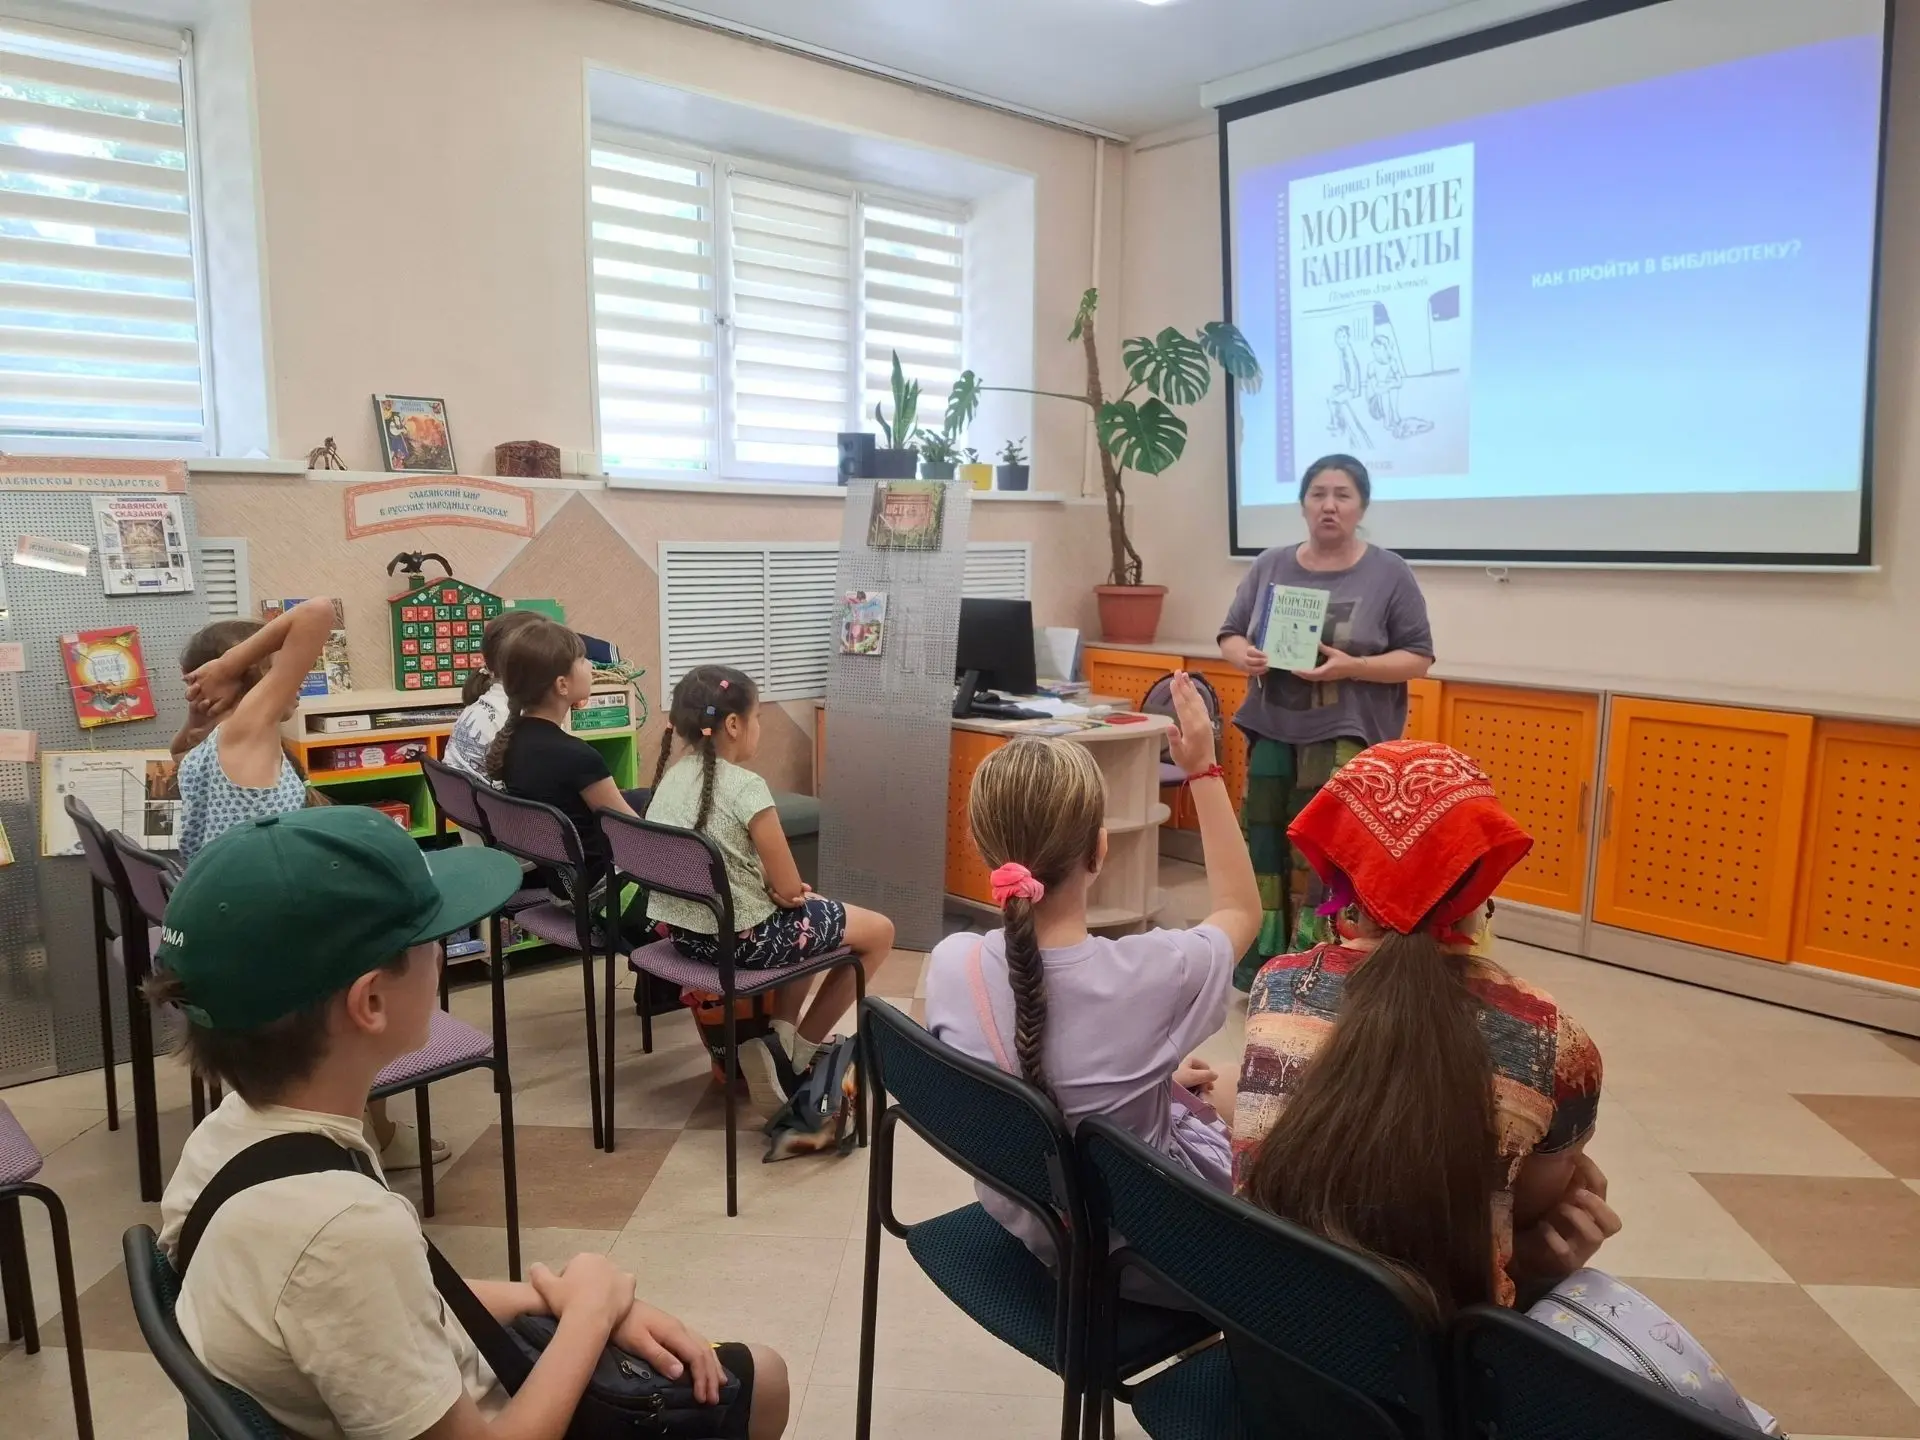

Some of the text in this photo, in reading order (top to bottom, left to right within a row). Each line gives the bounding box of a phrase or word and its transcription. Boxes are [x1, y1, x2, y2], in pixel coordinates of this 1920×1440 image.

[1301, 178, 1464, 250] МОРСКИЕ
[1302, 226, 1462, 288] КАНИКУЛЫ
[1531, 237, 1803, 289] КАК ПРОЙТИ В БИБЛИОТЕКУ?
[78, 476, 162, 487] ГОСУДАРСТВЕ
[408, 487, 461, 499] СЛАВЯНСКИЙ
[108, 502, 168, 511] СЛАВЯНСКИЕ
[115, 510, 164, 518] СКАЗАНИЯ
[387, 504, 425, 515] РУССКИХ
[426, 501, 471, 511] НАРОДНЫХ
[472, 504, 508, 518] СКАЗКАХ
[1277, 595, 1323, 611] МОРСКИЕ
[1274, 605, 1321, 620] КАНИКУЛЫ
